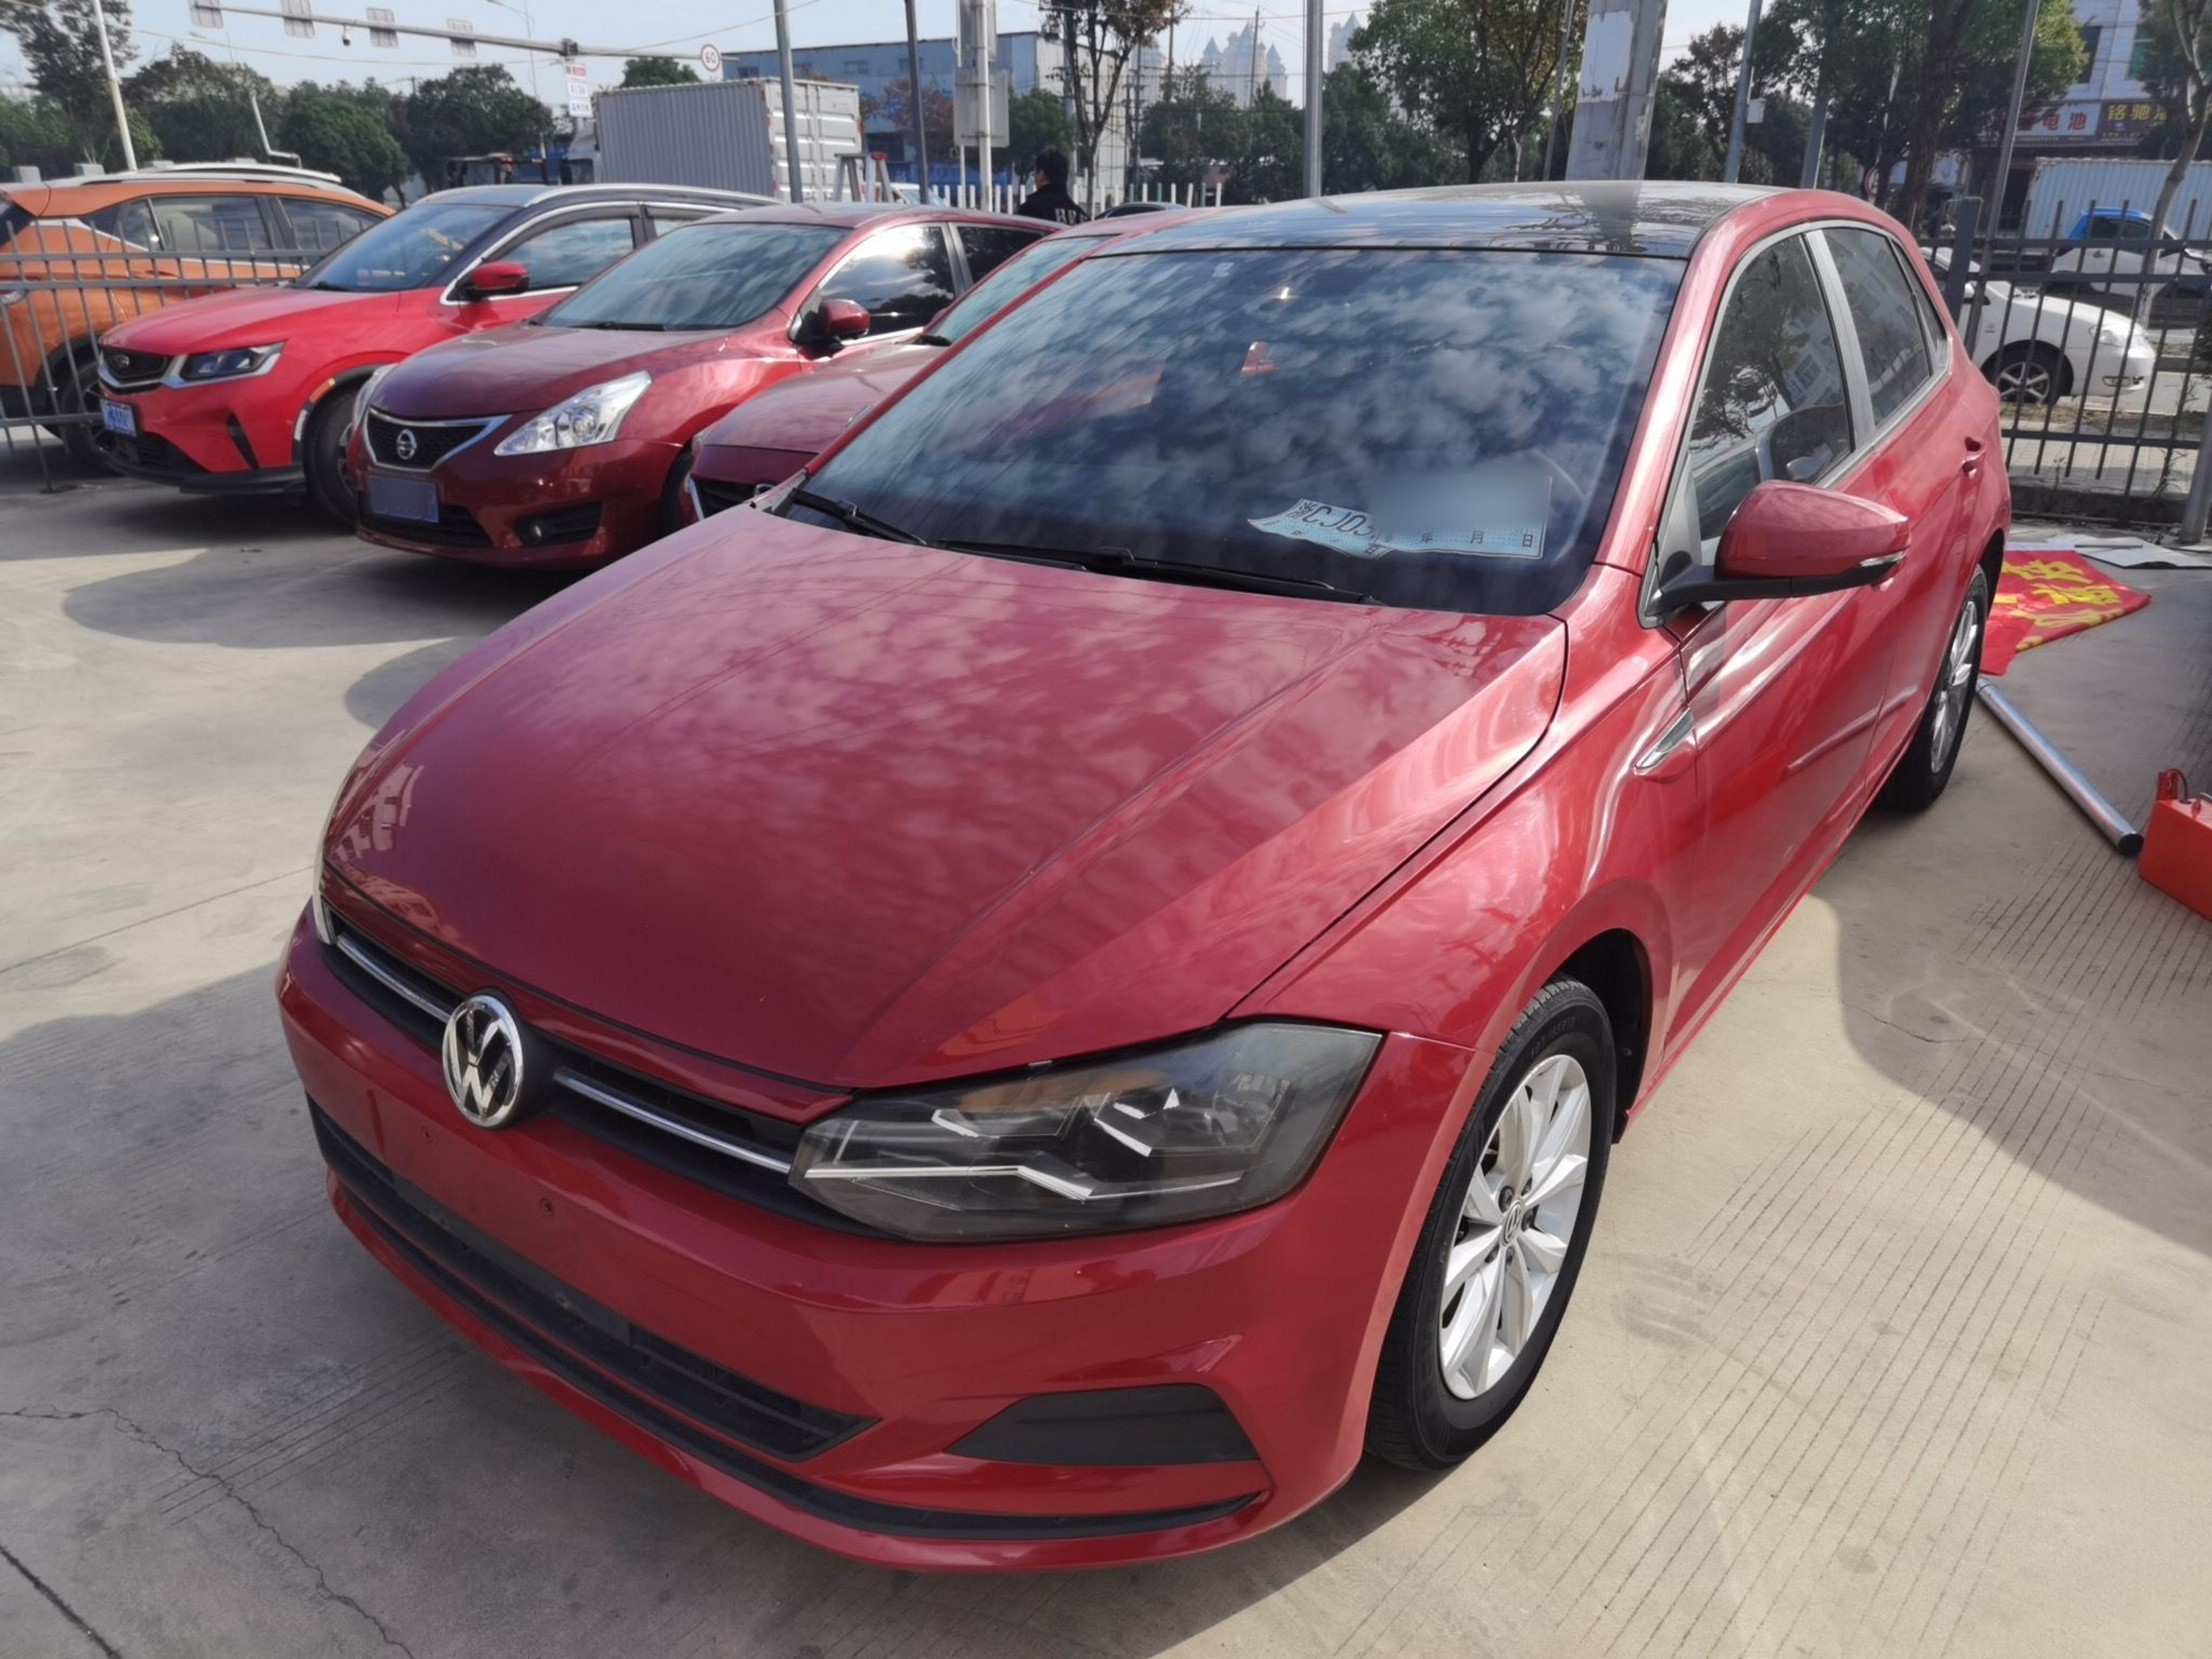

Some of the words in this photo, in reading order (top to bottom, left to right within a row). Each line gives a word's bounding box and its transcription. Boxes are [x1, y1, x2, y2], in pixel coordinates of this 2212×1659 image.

[704, 51, 717, 65] 60
[1470, 530, 1484, 544] 月
[1522, 533, 1534, 548] 日
